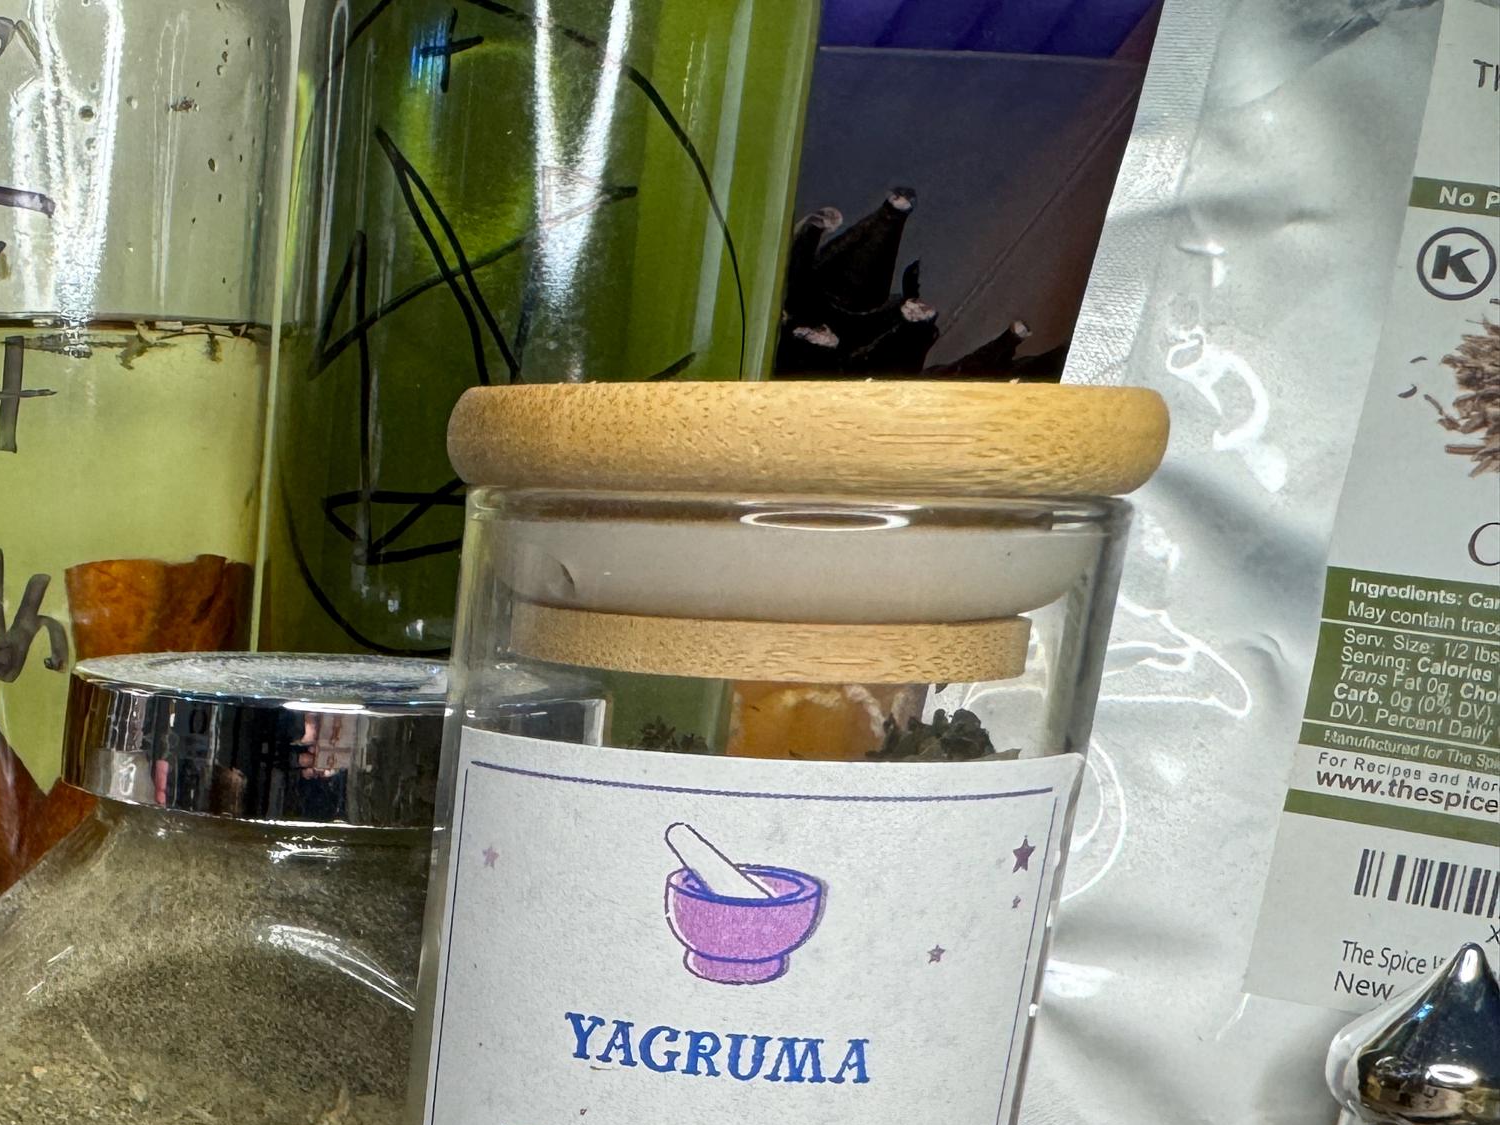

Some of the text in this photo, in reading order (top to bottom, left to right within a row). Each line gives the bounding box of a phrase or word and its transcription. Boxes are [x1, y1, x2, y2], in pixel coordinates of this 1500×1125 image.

[1439, 186, 1476, 207] No
[1351, 577, 1463, 606] Ingredients:
[1347, 600, 1387, 624] May
[1390, 610, 1455, 630] contain
[1343, 628, 1386, 649] Serv.
[1392, 634, 1436, 655] Size:
[1444, 641, 1469, 660] 1/2
[1340, 646, 1493, 682] Serving: Calories
[1340, 664, 1388, 686] Trans
[1390, 690, 1413, 713] 0g
[1375, 708, 1443, 734] Percent
[1448, 719, 1493, 744] Daily
[1423, 743, 1443, 761] for
[1318, 751, 1500, 793] For Recipes and Mor
[1342, 940, 1375, 966] The
[1378, 947, 1427, 976] Spice
[1334, 970, 1395, 1000] New
[565, 1011, 870, 1084] YAGRUMA
